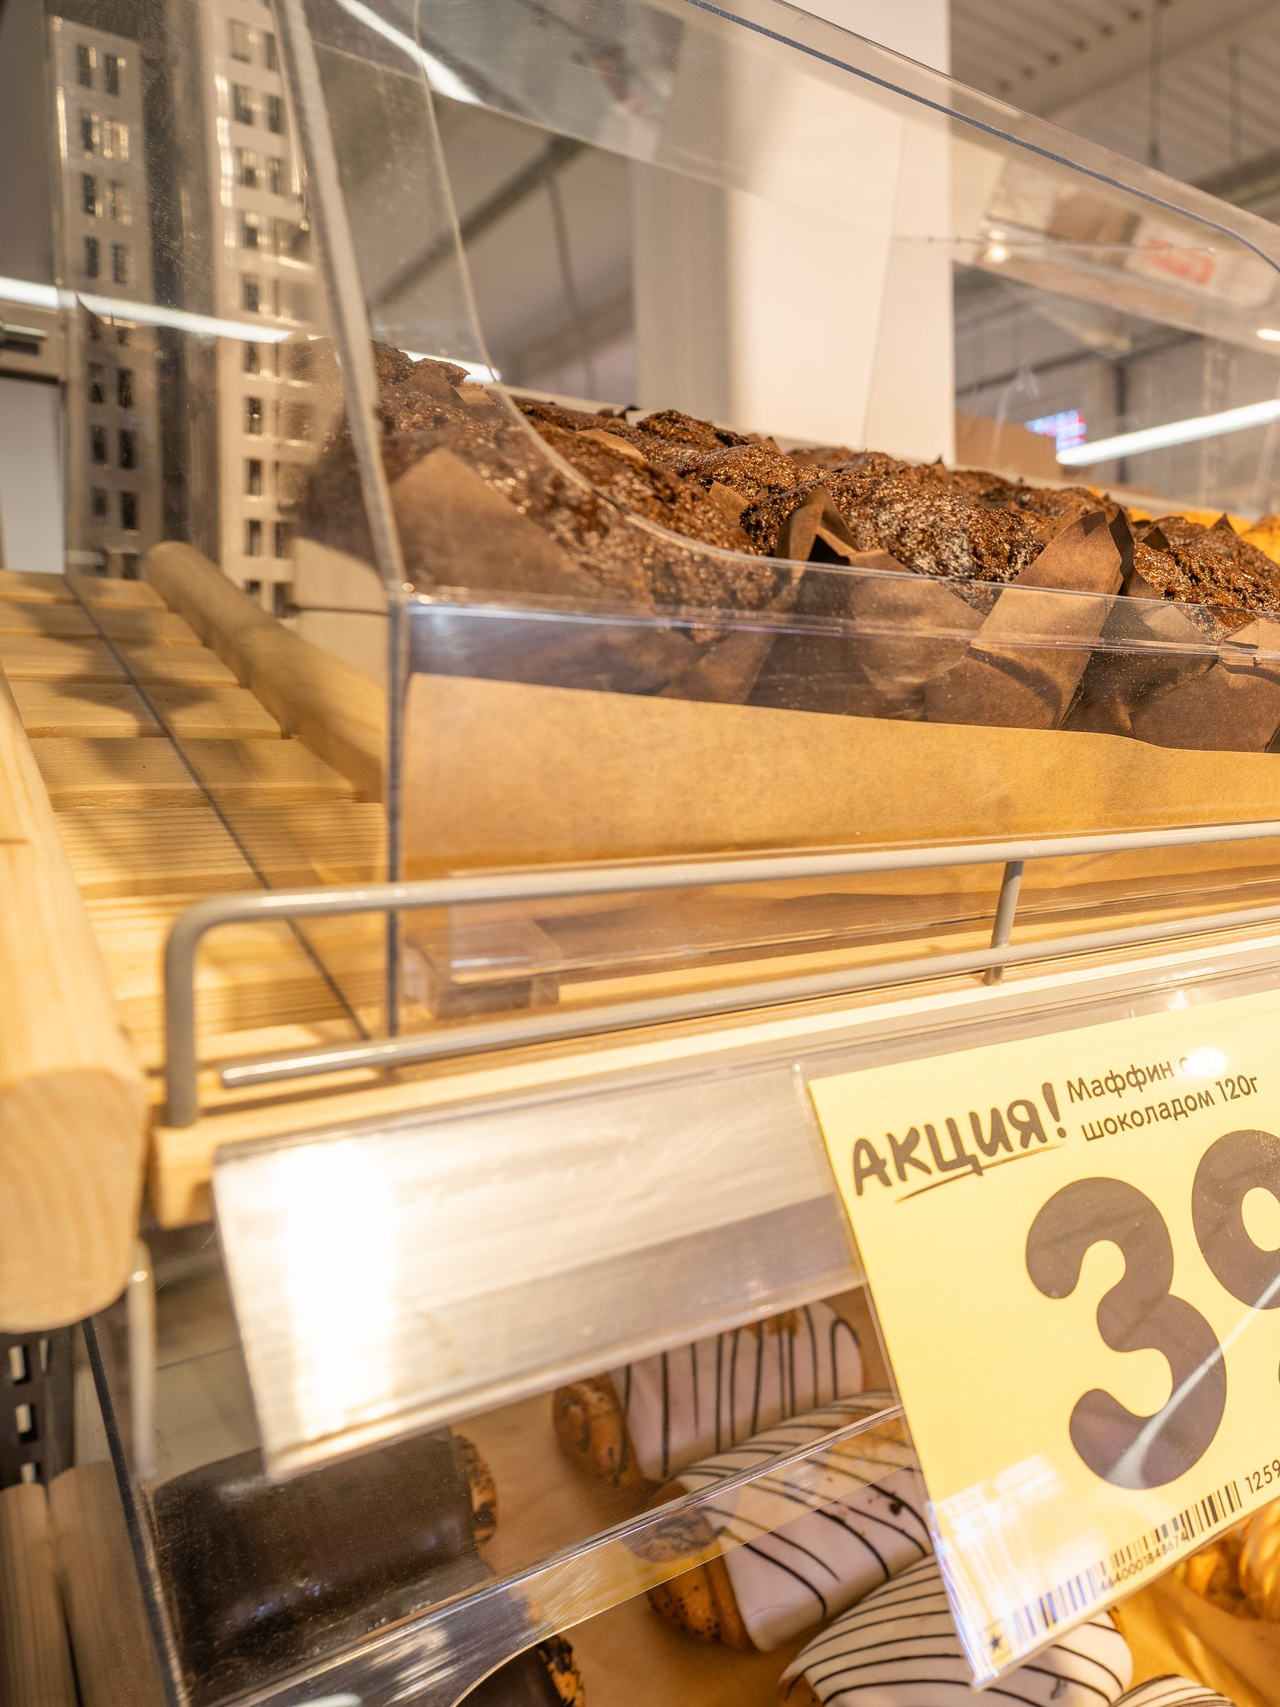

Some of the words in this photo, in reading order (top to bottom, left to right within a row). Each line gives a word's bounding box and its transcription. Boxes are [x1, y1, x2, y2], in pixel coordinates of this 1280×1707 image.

[1066, 1060, 1175, 1104] Маффин
[1081, 1089, 1215, 1142] шоколадом
[1215, 1074, 1258, 1102] 120г
[852, 1081, 1067, 1197] АКЦИЯ!
